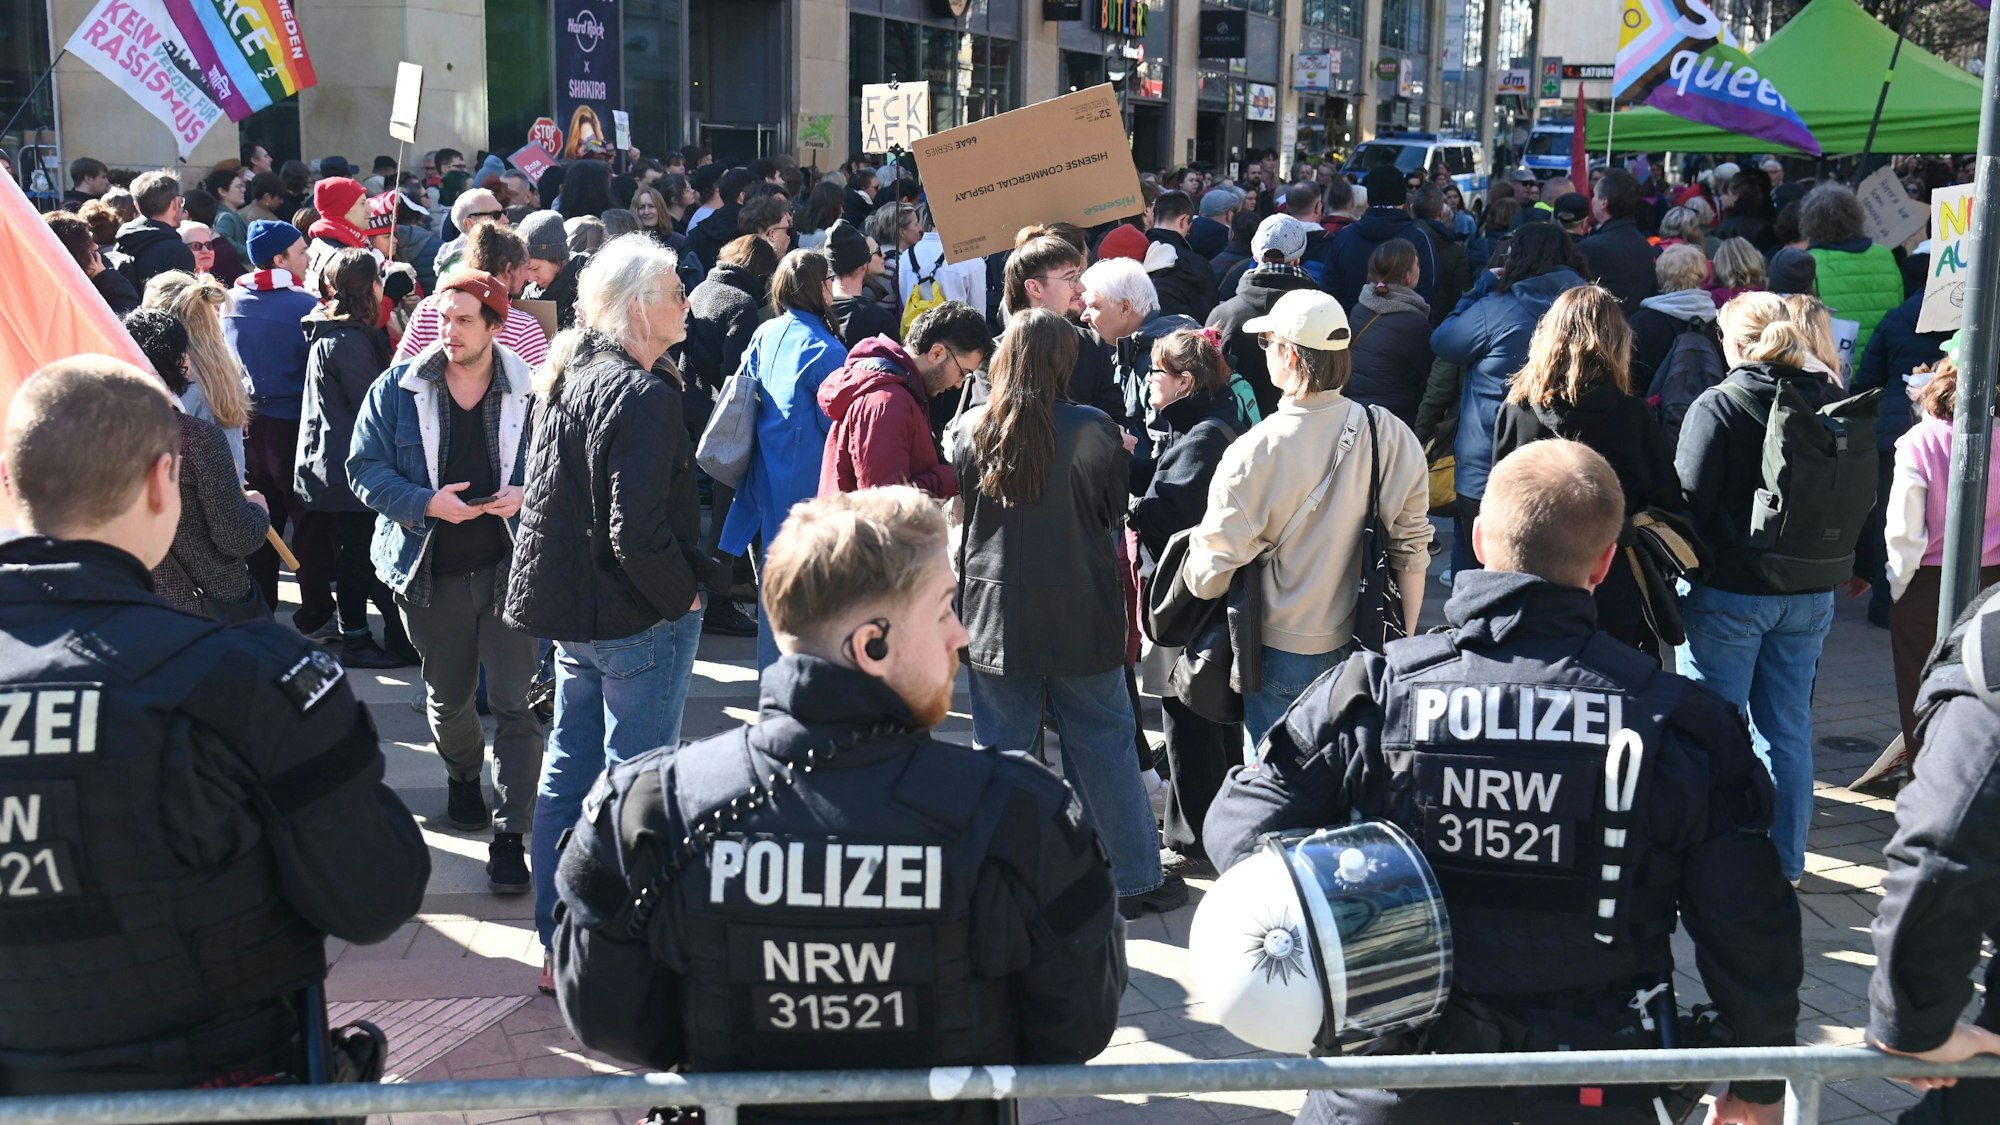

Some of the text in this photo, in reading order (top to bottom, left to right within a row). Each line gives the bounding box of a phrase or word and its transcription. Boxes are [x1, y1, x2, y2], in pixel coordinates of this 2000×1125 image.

[101, 1, 161, 49] KEIN
[82, 19, 205, 143] RASSISMUS
[569, 79, 606, 100] SHAKIRA
[1503, 72, 1524, 86] dm
[1580, 66, 1614, 78] SATURN
[866, 92, 923, 124] FCK
[534, 124, 556, 139] STOP
[925, 136, 977, 158] 66AE SERIES
[523, 159, 542, 174] Rote
[955, 151, 1108, 202] HISENSE COMMERCIAL DISPLAY
[1083, 194, 1137, 216] Hisense
[1415, 686, 1624, 746] POLIZEI
[1441, 766, 1562, 813] NRW
[1438, 812, 1561, 863] 31521
[709, 839, 942, 909] POLIZEI
[763, 939, 896, 984] NRW
[768, 990, 905, 1030] 31521
